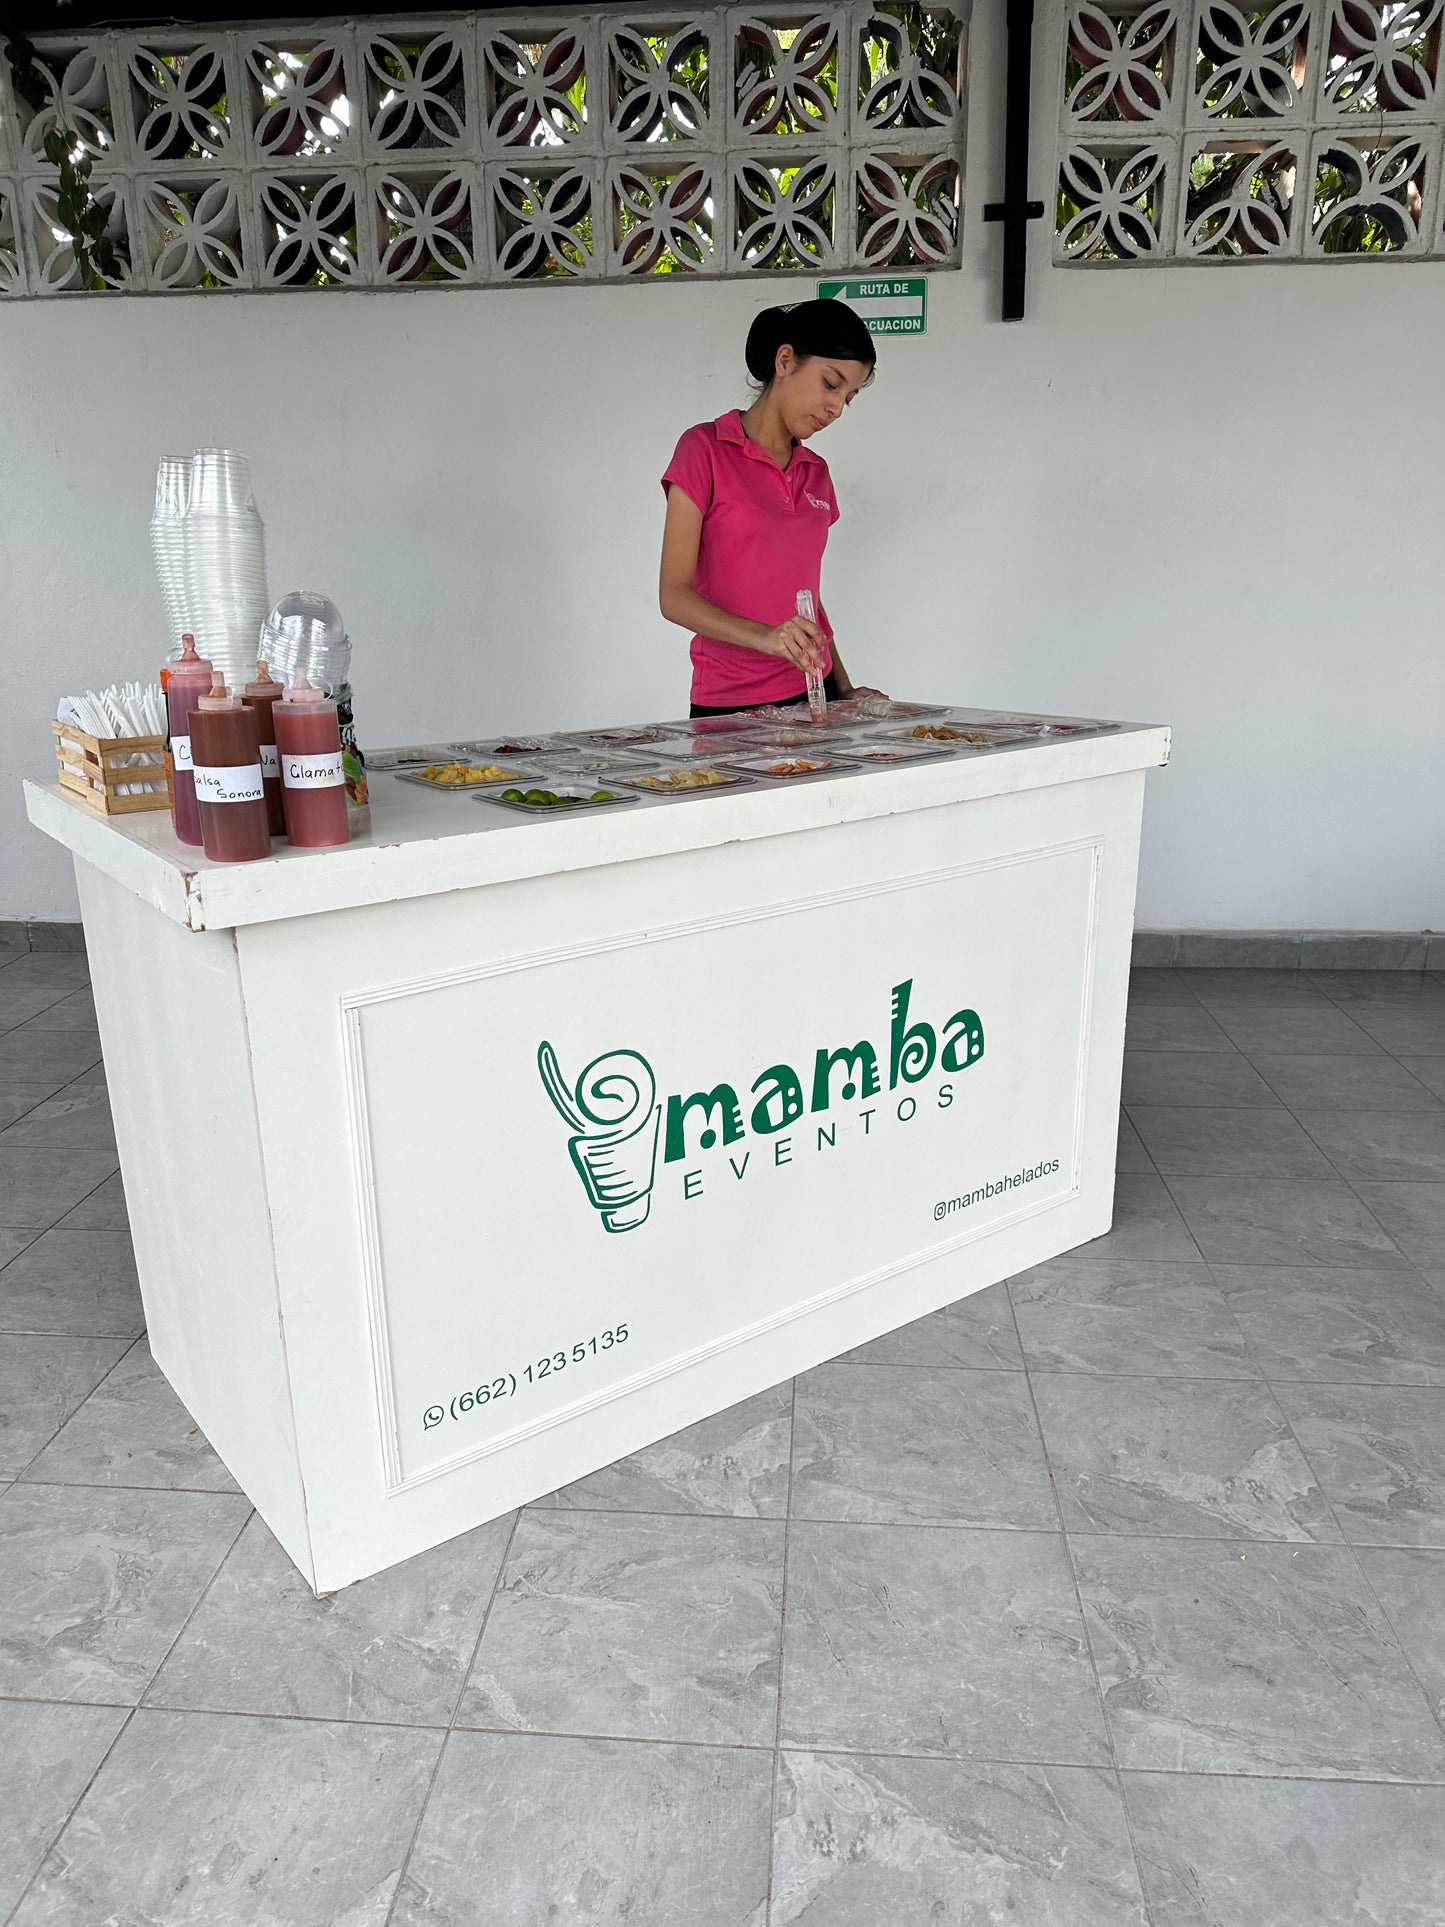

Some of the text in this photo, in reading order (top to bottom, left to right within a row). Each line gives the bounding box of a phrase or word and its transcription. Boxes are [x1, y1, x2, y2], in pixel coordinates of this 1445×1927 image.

[860, 283, 909, 295] RUTA DE
[864, 319, 920, 331] CUACION
[664, 978, 985, 1164] mamba
[684, 1084, 954, 1200] EVENTOS
[450, 1323, 629, 1420] (662) 123 5135
